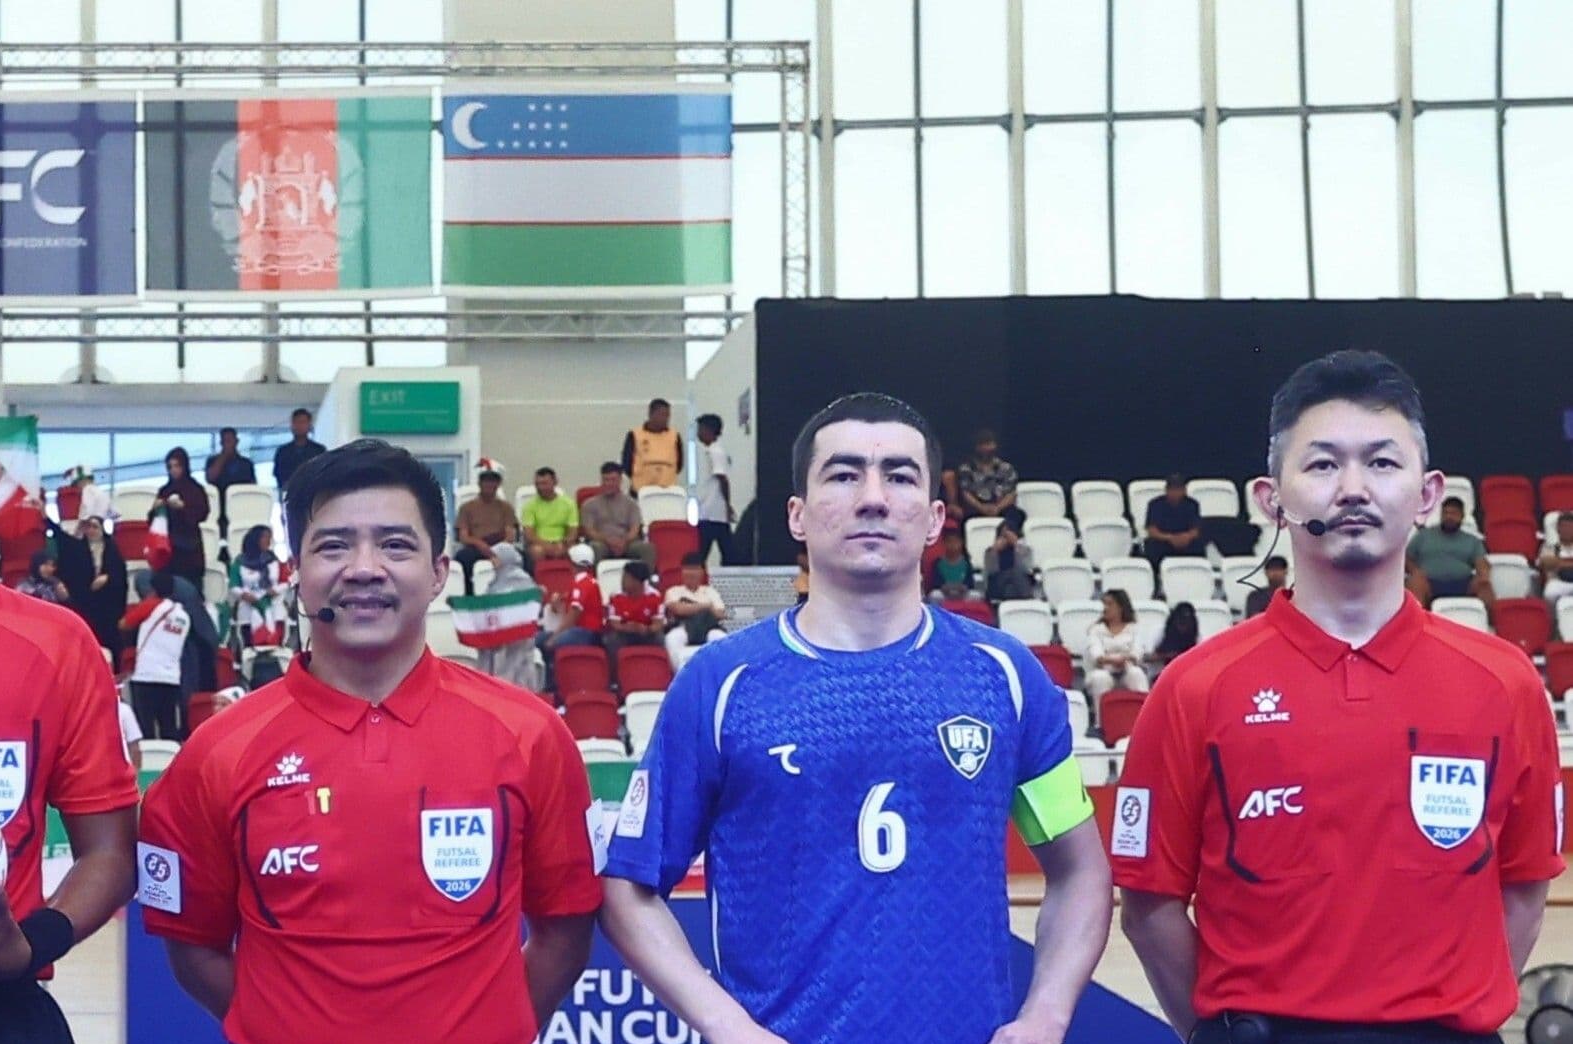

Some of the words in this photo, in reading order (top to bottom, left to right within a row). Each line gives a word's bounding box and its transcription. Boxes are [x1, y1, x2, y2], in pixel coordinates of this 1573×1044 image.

[1244, 712, 1291, 724] KELME
[947, 727, 985, 750] UFA
[267, 773, 310, 787] KELME
[1419, 763, 1477, 786] FIFA
[1239, 786, 1304, 820] AFC
[1426, 794, 1468, 805] FUTSAL
[1423, 805, 1472, 817] REFEREE
[428, 815, 486, 837] FIFA
[858, 782, 907, 873] 6
[1432, 828, 1462, 840] 2026
[435, 847, 478, 858] FUTSAL
[259, 845, 320, 875] AFC
[433, 857, 482, 869] REFEREE
[444, 879, 472, 892] 2026
